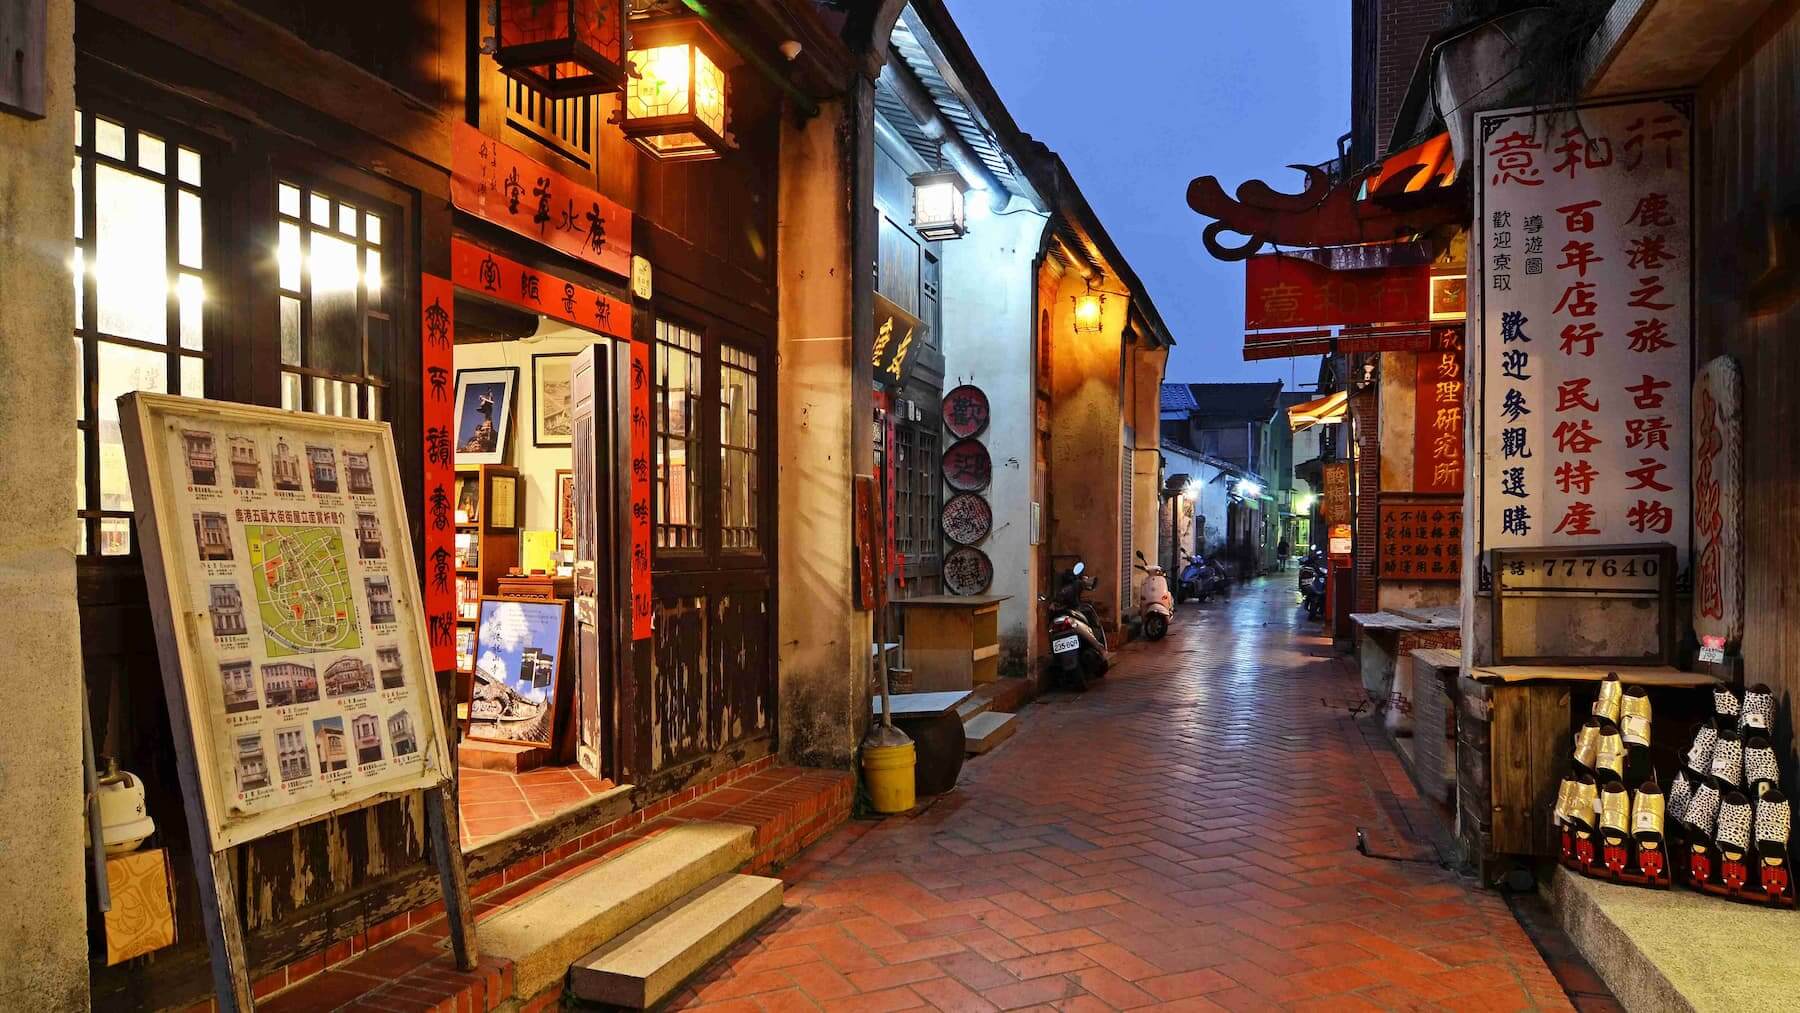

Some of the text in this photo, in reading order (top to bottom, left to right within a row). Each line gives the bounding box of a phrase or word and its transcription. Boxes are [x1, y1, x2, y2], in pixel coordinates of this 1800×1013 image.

[1489, 115, 1683, 186] 意和行
[1523, 215, 1544, 275] 導遊圖
[1500, 310, 1532, 537] 歡迎參觀選購
[1552, 200, 1604, 536] 百年店行 民俗特產
[1624, 192, 1677, 534] 鹿港之旅 古蹟文物
[1542, 558, 1659, 578] 777640
